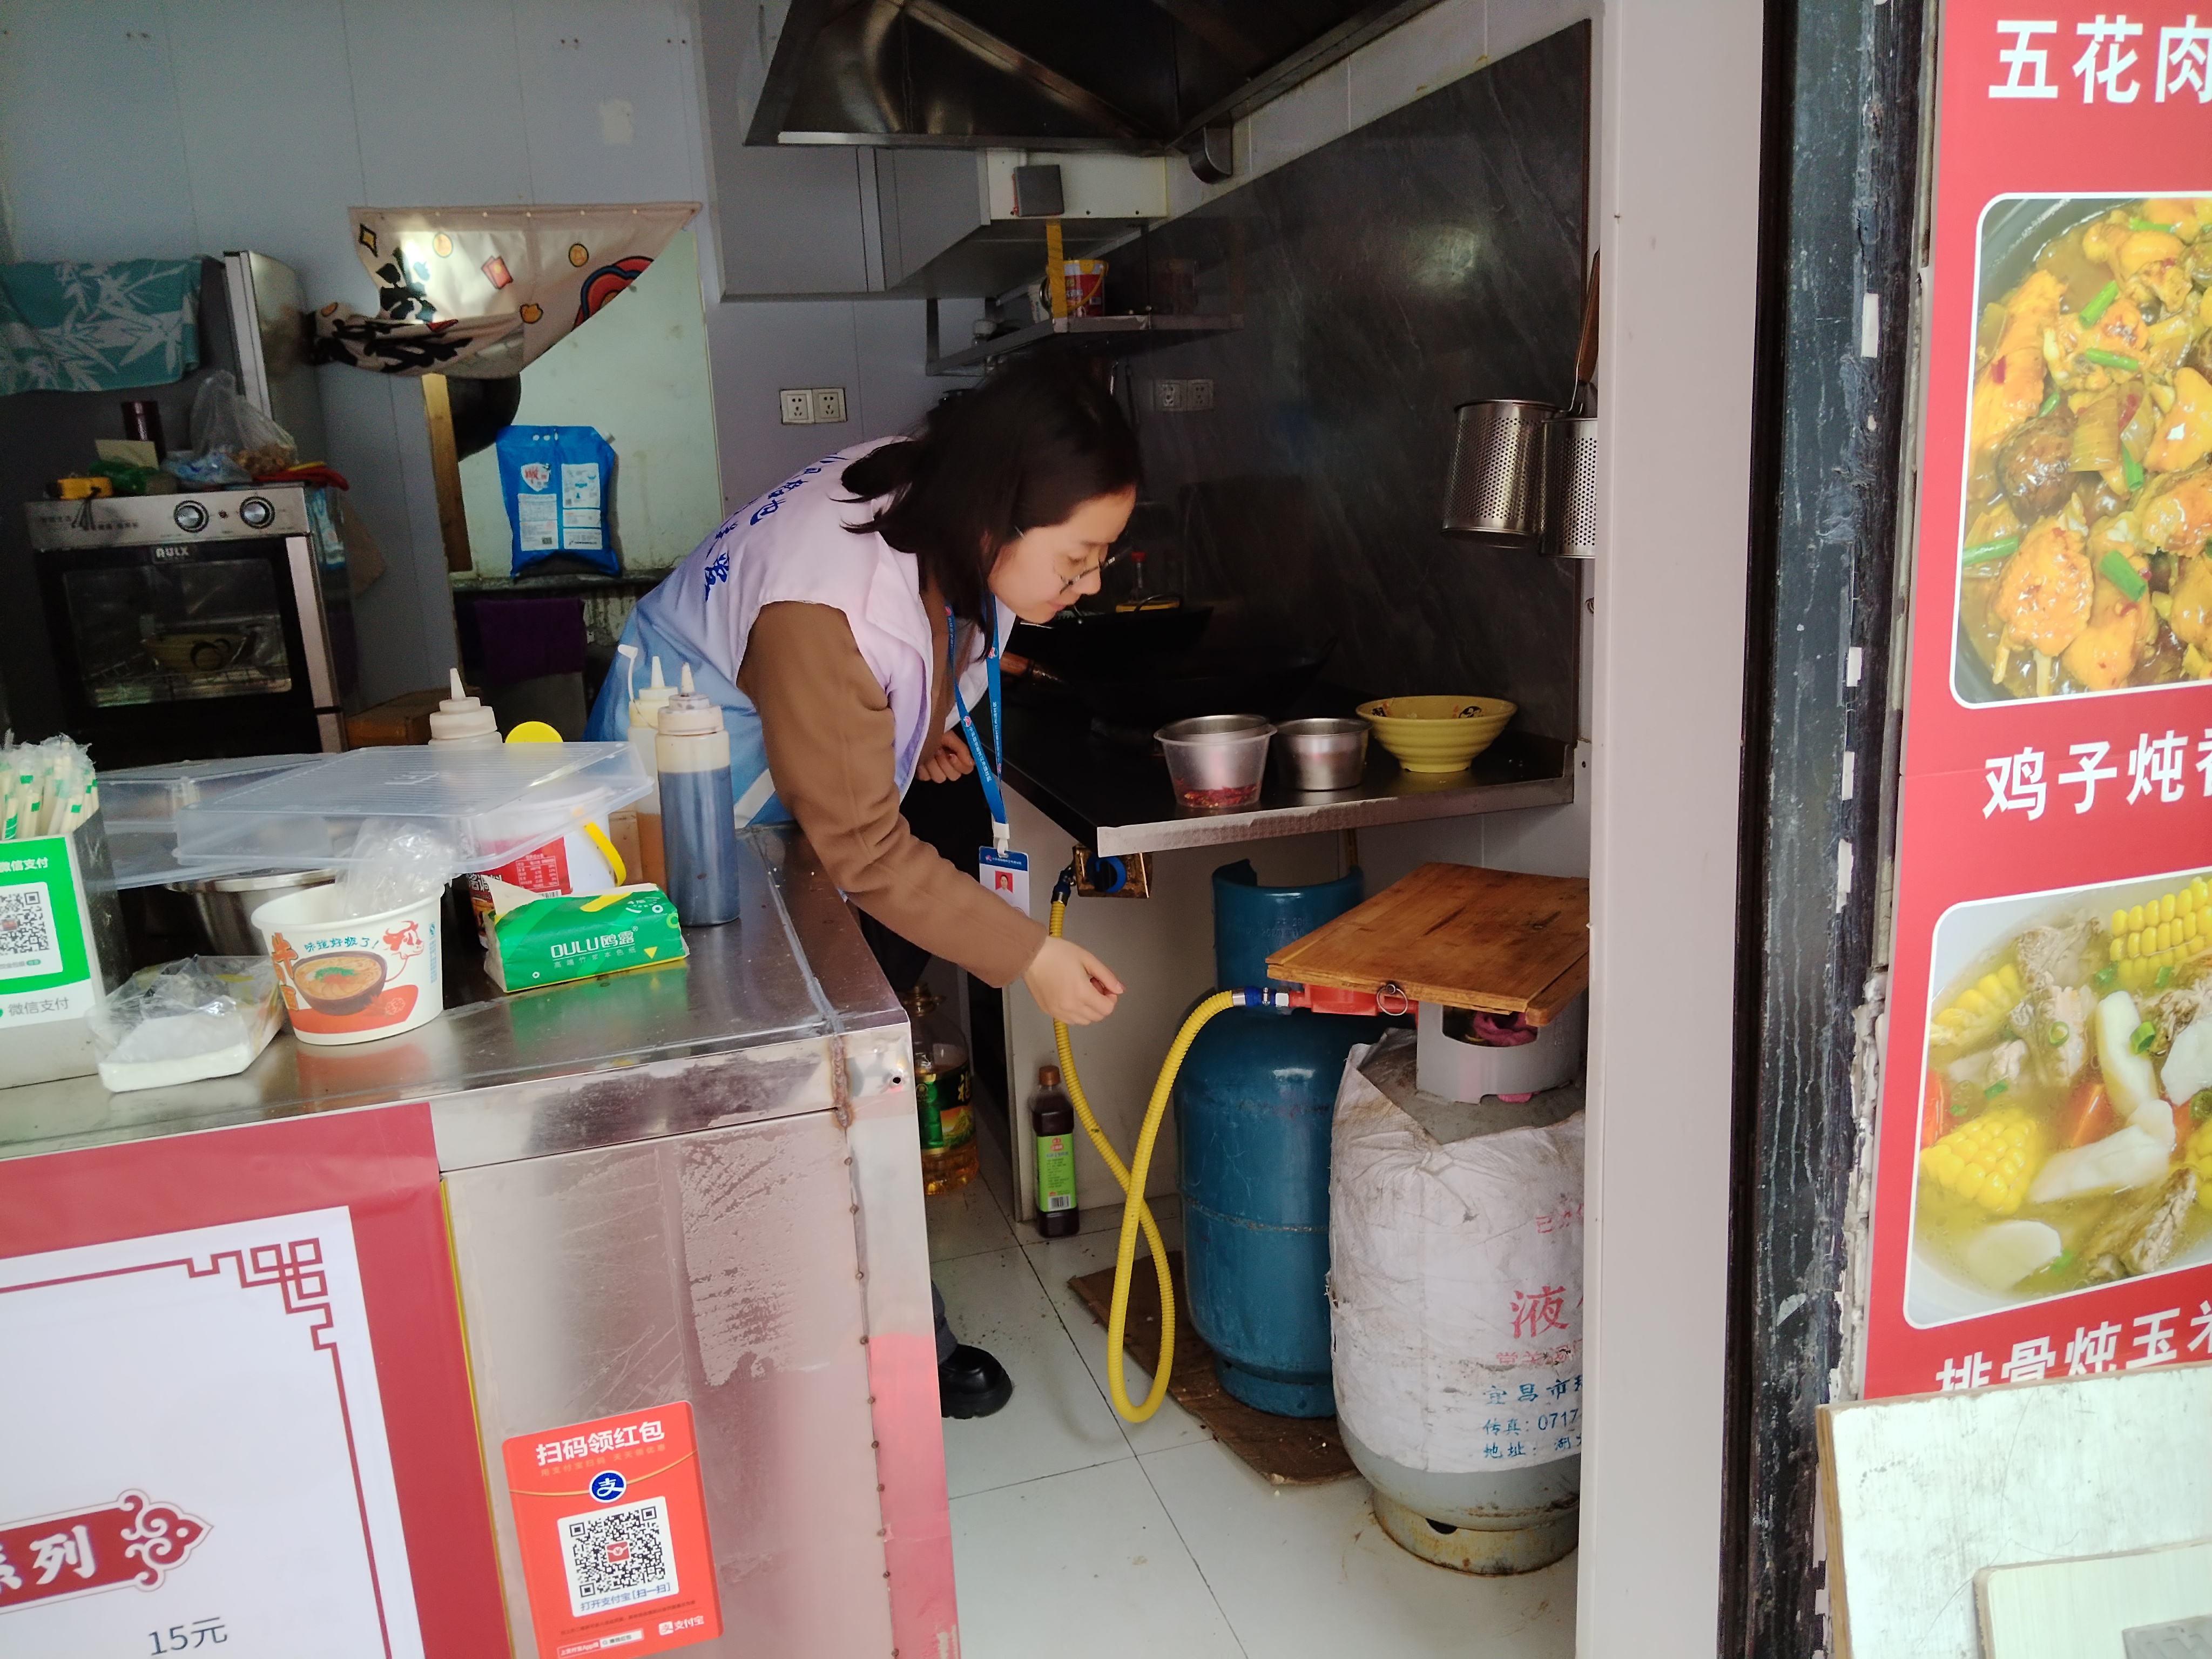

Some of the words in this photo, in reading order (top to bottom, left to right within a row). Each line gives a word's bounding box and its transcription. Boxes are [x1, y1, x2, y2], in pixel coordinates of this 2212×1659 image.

[1989, 15, 2212, 104] 五花肉
[8, 997, 69, 1016] 微信支付
[536, 1420, 665, 1466] 扫码领红包
[149, 1617, 227, 1656] 15元
